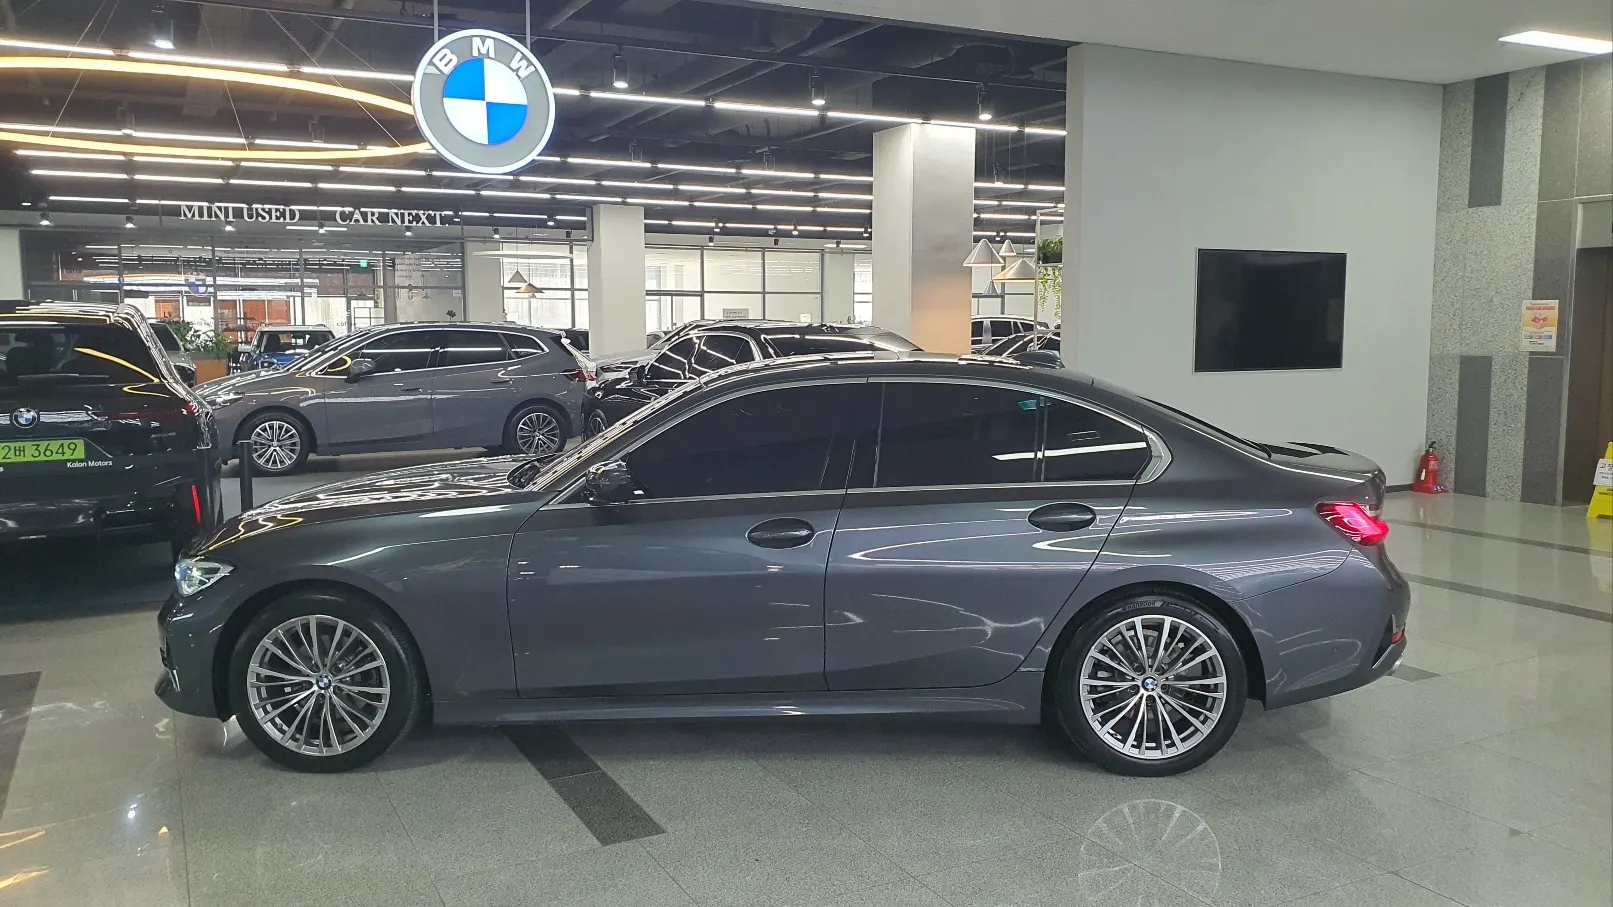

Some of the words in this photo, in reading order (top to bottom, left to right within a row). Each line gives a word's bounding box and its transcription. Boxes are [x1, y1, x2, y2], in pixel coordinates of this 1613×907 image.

[432, 36, 536, 80] BMW
[180, 204, 236, 221] MINI
[243, 206, 300, 222] USED
[335, 209, 382, 226] CAR
[31, 442, 78, 458] 3649
